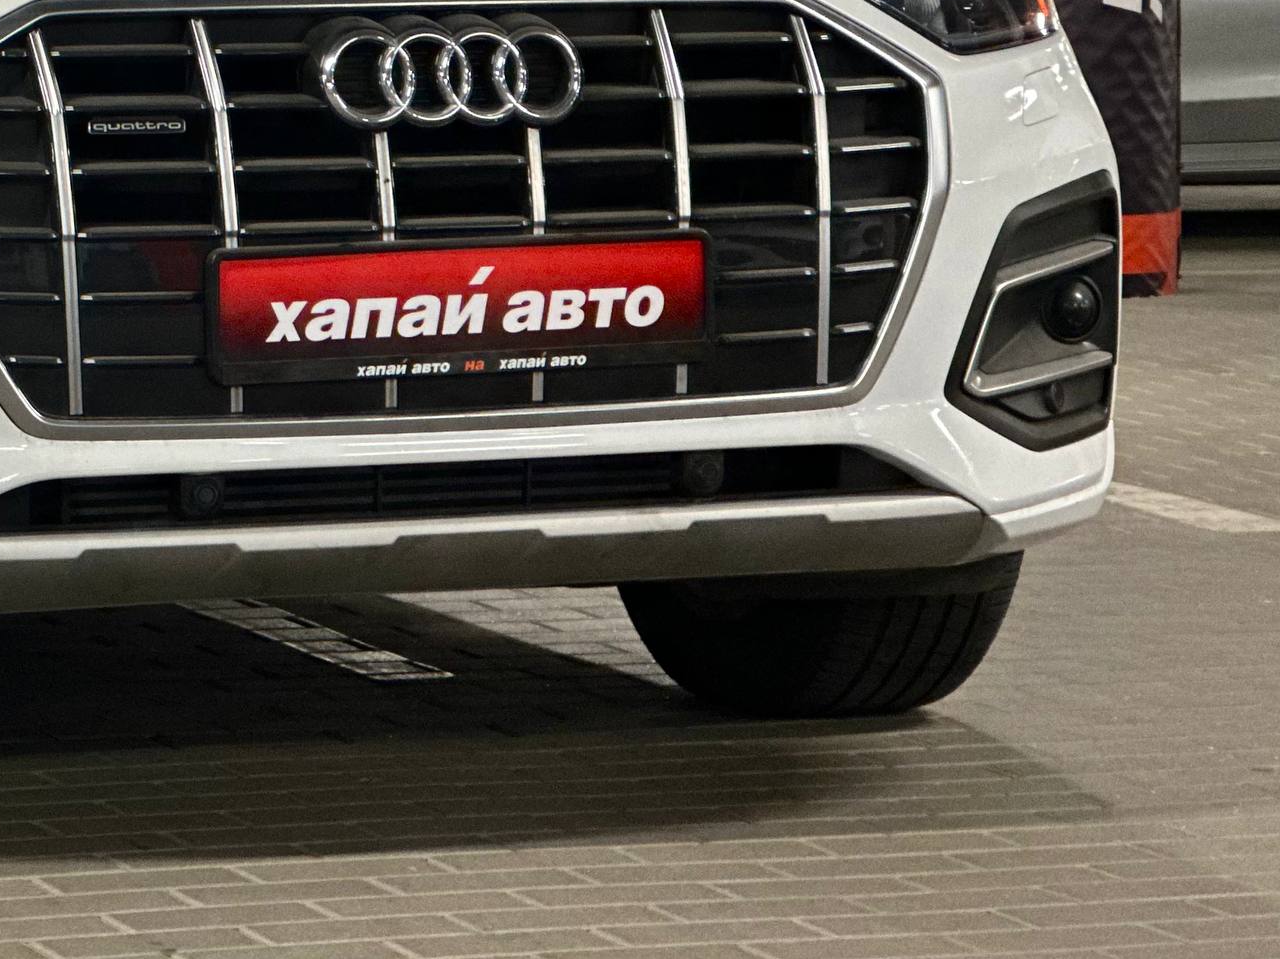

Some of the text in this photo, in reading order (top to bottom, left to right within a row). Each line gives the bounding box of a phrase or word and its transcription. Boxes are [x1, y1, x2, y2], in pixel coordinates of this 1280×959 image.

[92, 120, 181, 132] quattro
[265, 266, 665, 343] хапай авто
[356, 351, 587, 377] хапай авто на хапай авто
